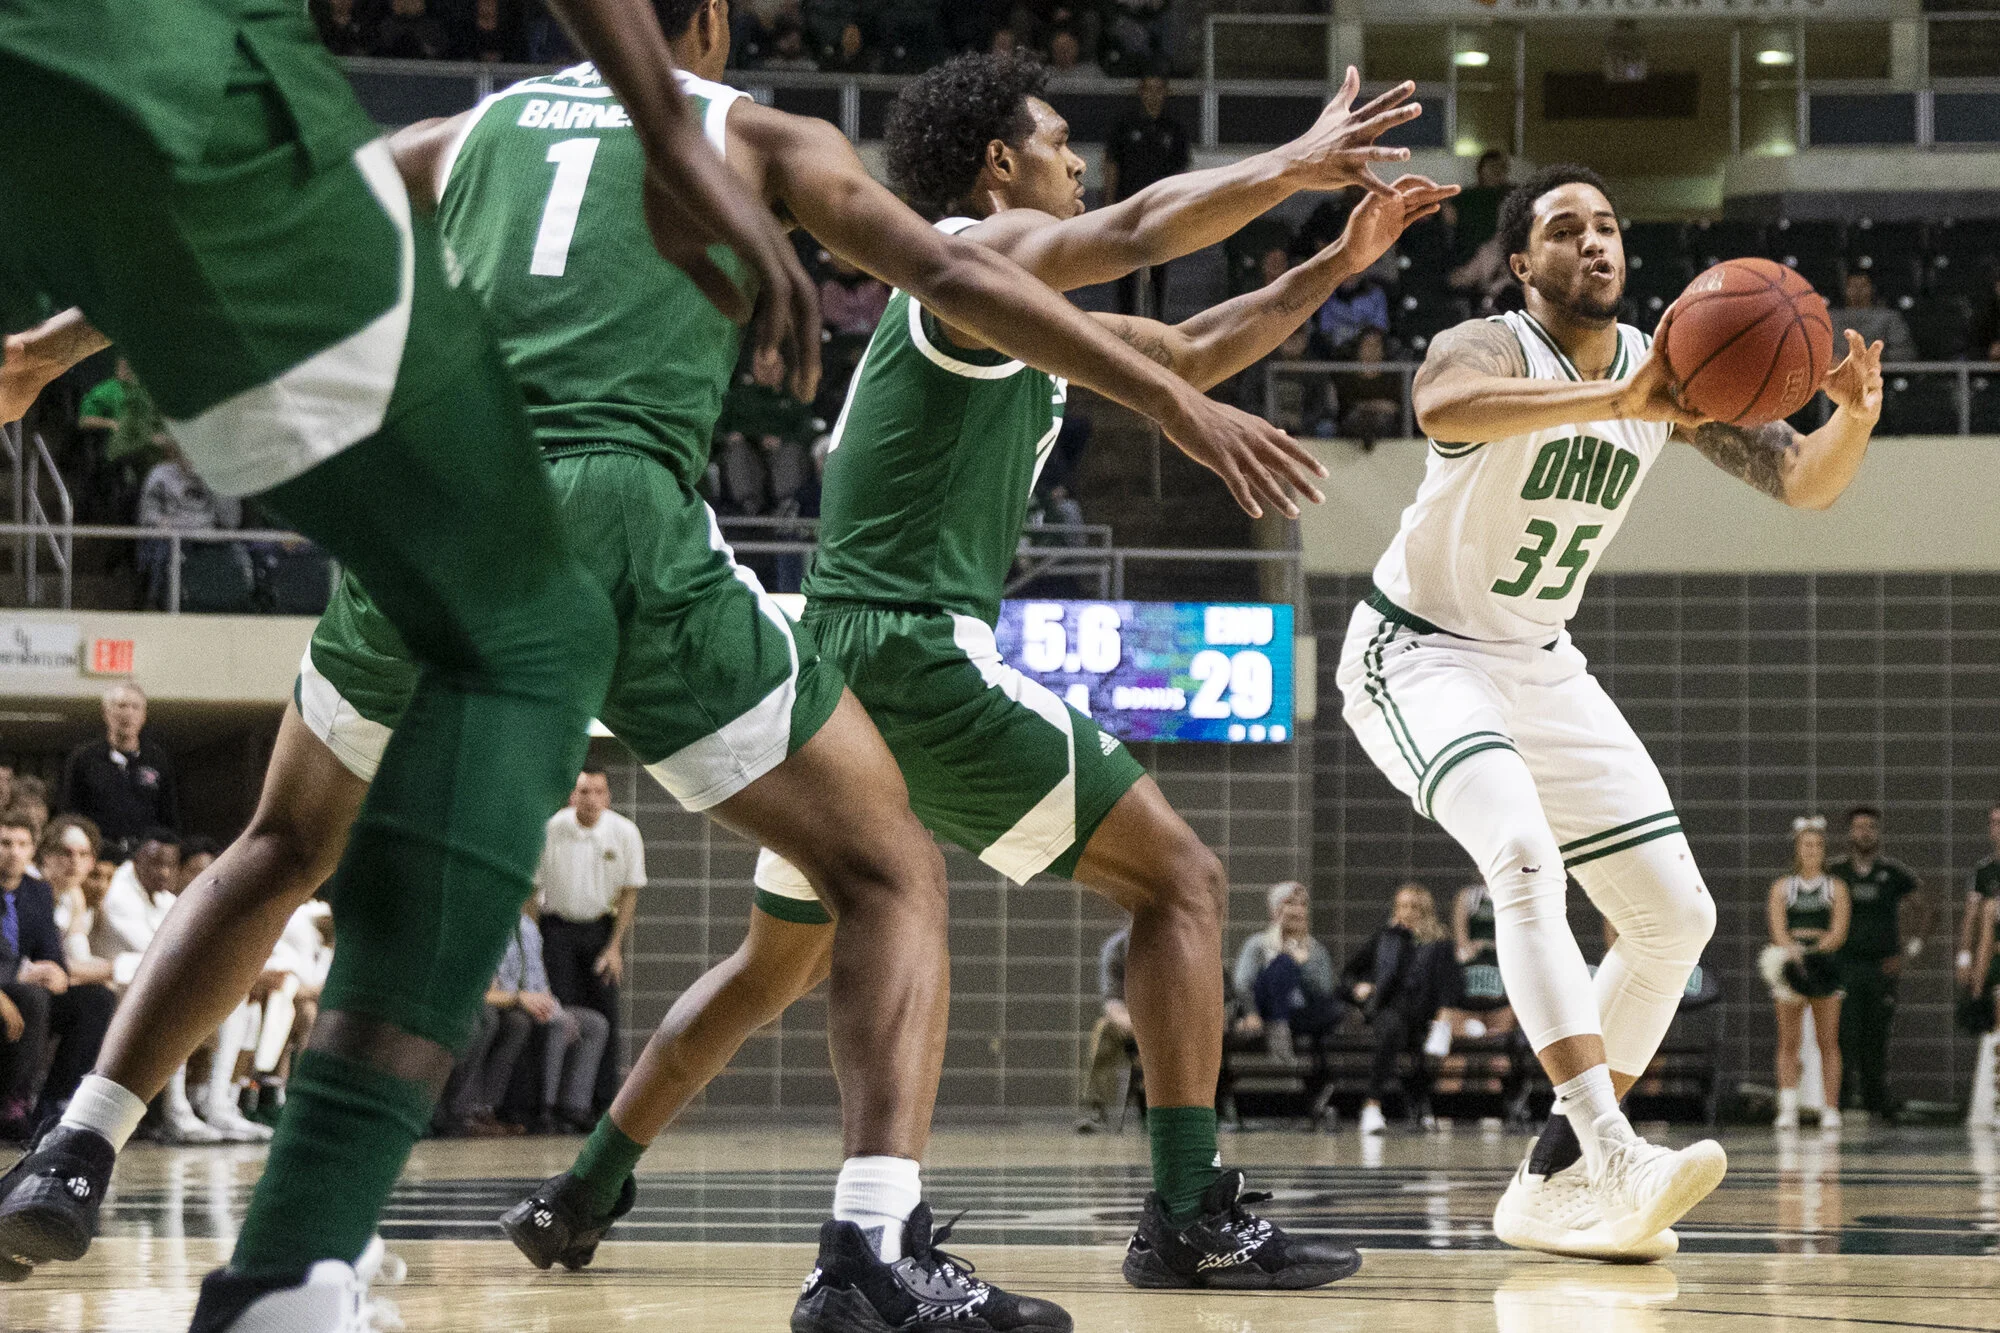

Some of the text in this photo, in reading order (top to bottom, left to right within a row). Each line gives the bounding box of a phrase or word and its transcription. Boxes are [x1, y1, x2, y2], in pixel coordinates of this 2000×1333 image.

[529, 137, 601, 277] 1
[1521, 435, 1640, 511] OHIO
[1490, 518, 1604, 600] 35
[1022, 603, 1121, 673] 5.6
[1189, 650, 1273, 719] 29
